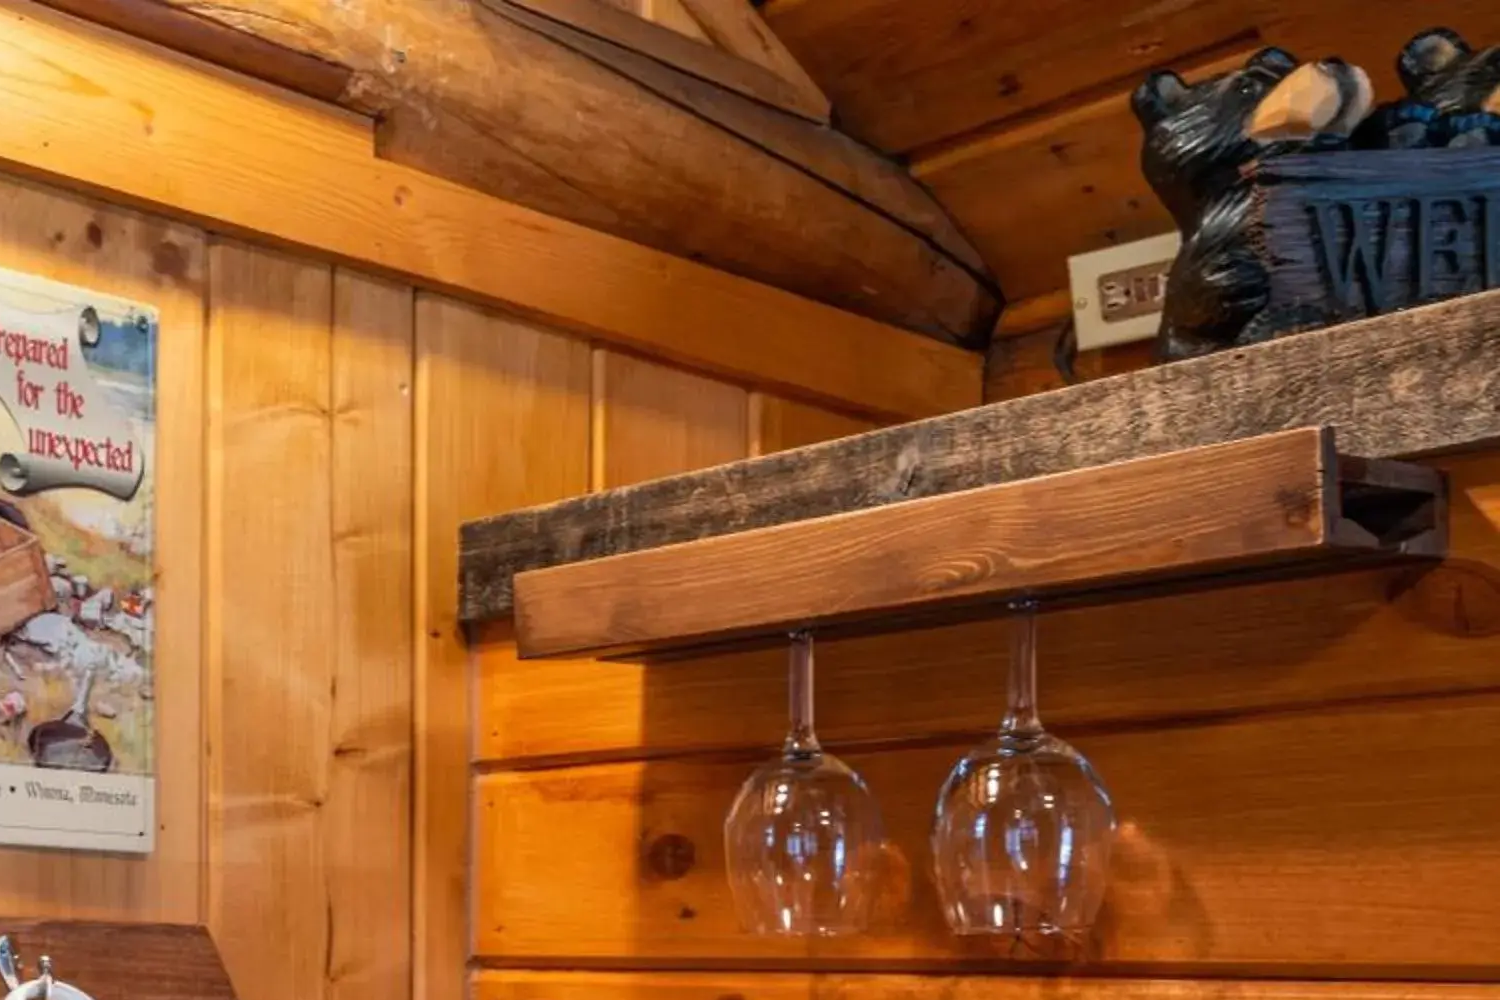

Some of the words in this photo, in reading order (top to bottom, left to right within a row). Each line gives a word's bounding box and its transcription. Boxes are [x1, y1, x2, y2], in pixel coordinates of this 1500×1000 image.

[1305, 198, 1500, 312] WE
[16, 369, 45, 411] for
[54, 380, 86, 420] the
[28, 427, 133, 474] unexpected
